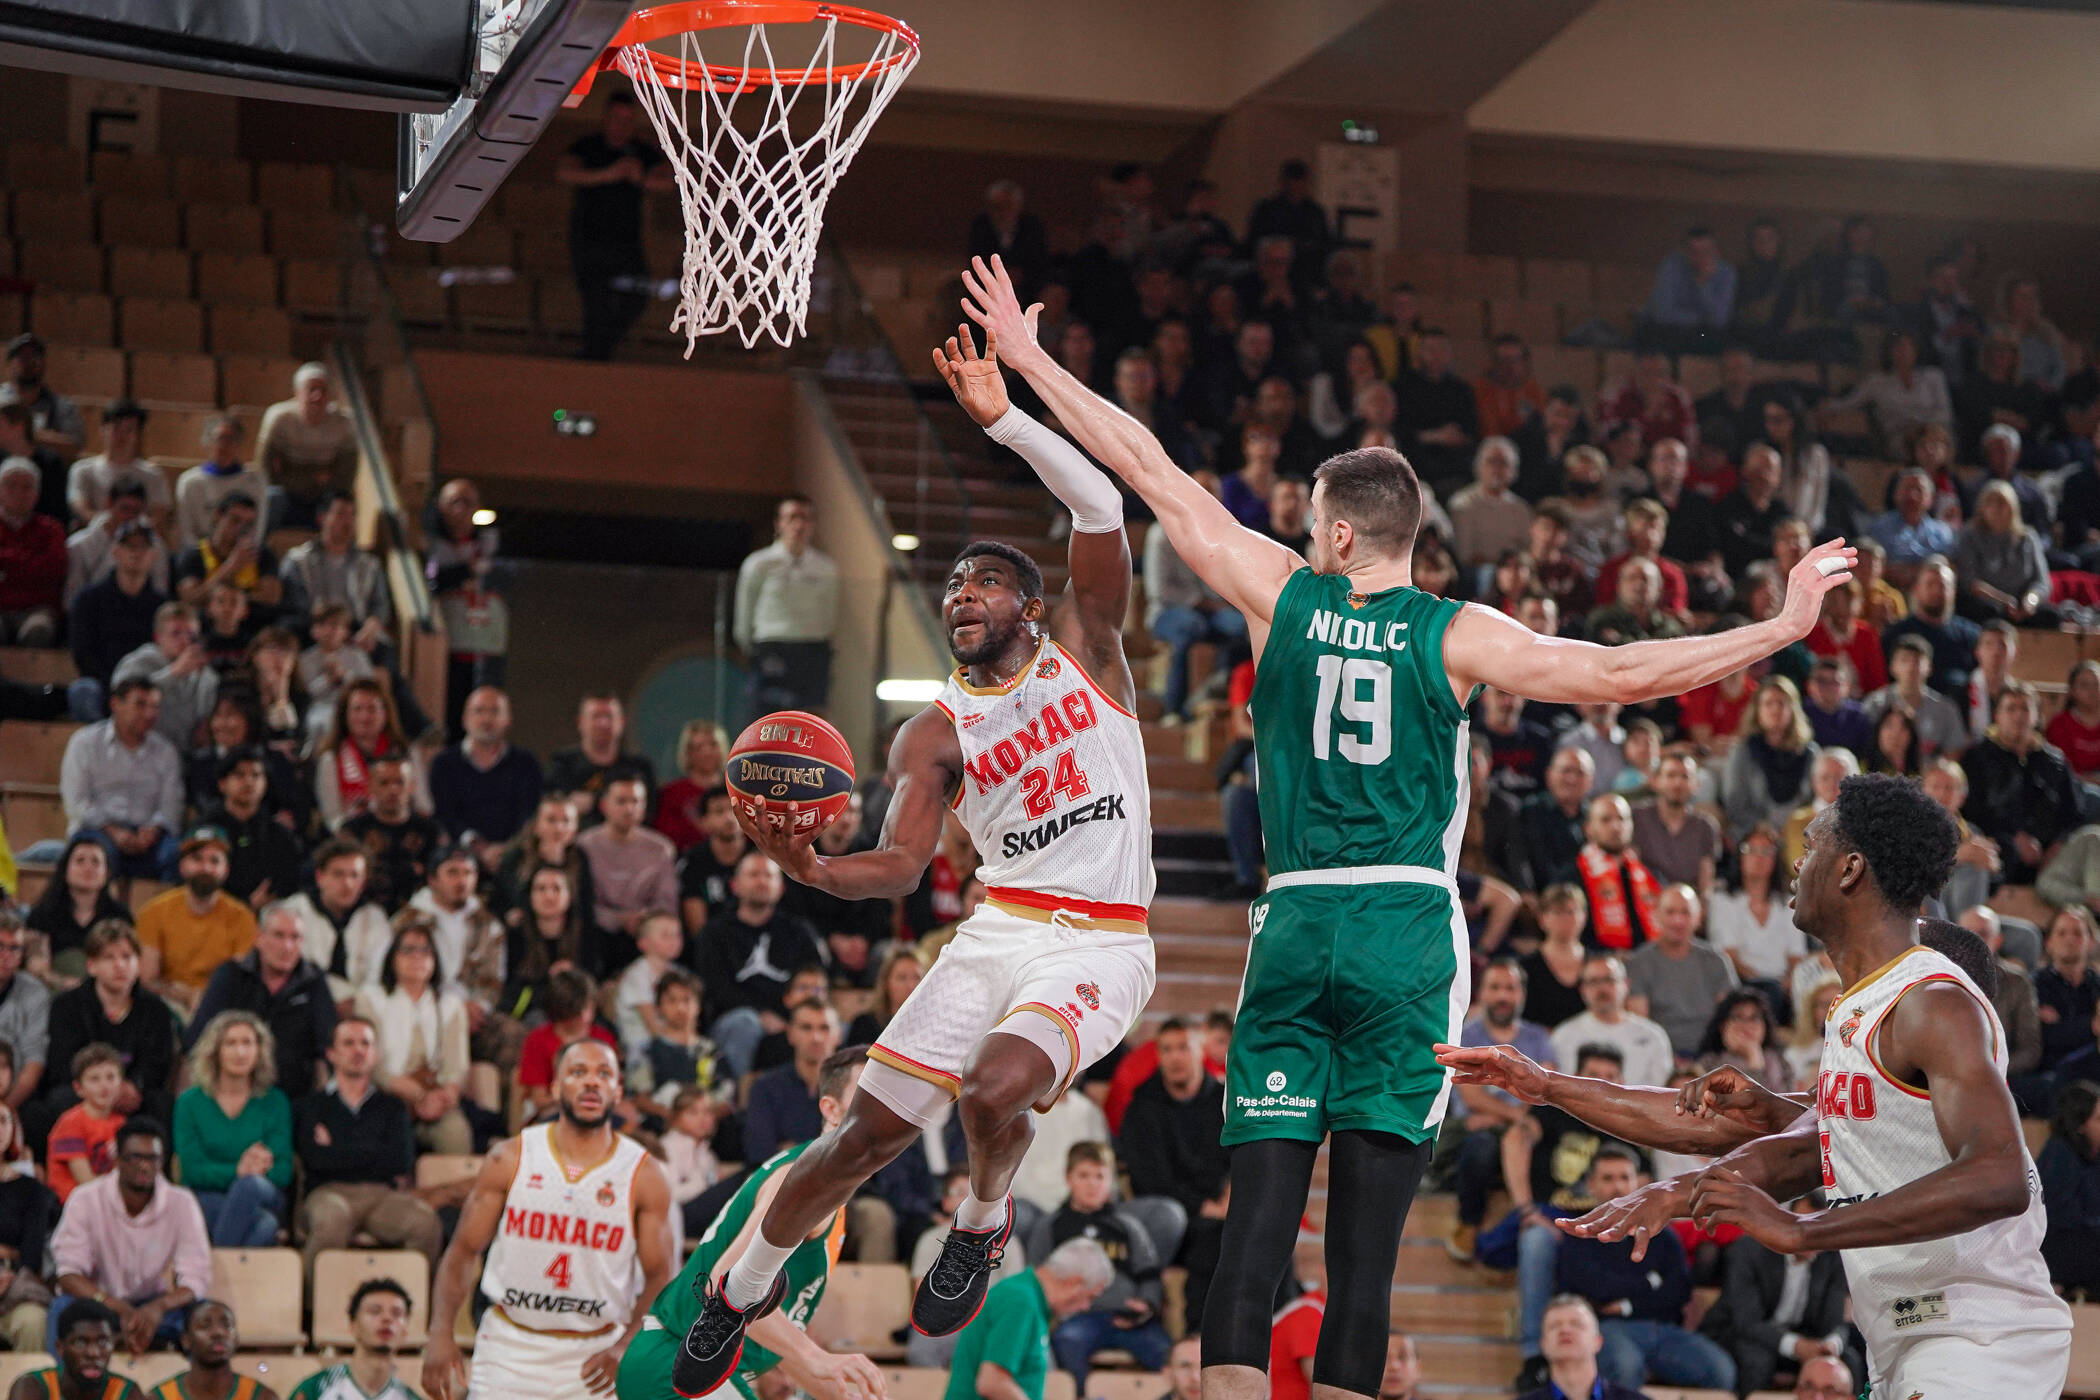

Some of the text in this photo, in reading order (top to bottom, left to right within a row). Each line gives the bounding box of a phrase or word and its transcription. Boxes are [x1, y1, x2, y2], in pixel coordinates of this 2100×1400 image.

[1313, 654, 1393, 766] 19
[760, 723, 803, 745] LNB
[741, 758, 825, 789] SPALDING
[1019, 747, 1091, 821] 24
[1002, 793, 1126, 859] SKWEEK
[1253, 903, 1270, 938] 19
[1269, 1076, 1283, 1086] 62
[505, 1206, 625, 1252] MONACO
[544, 1252, 572, 1290] 4
[502, 1287, 607, 1318] SKWEEK
